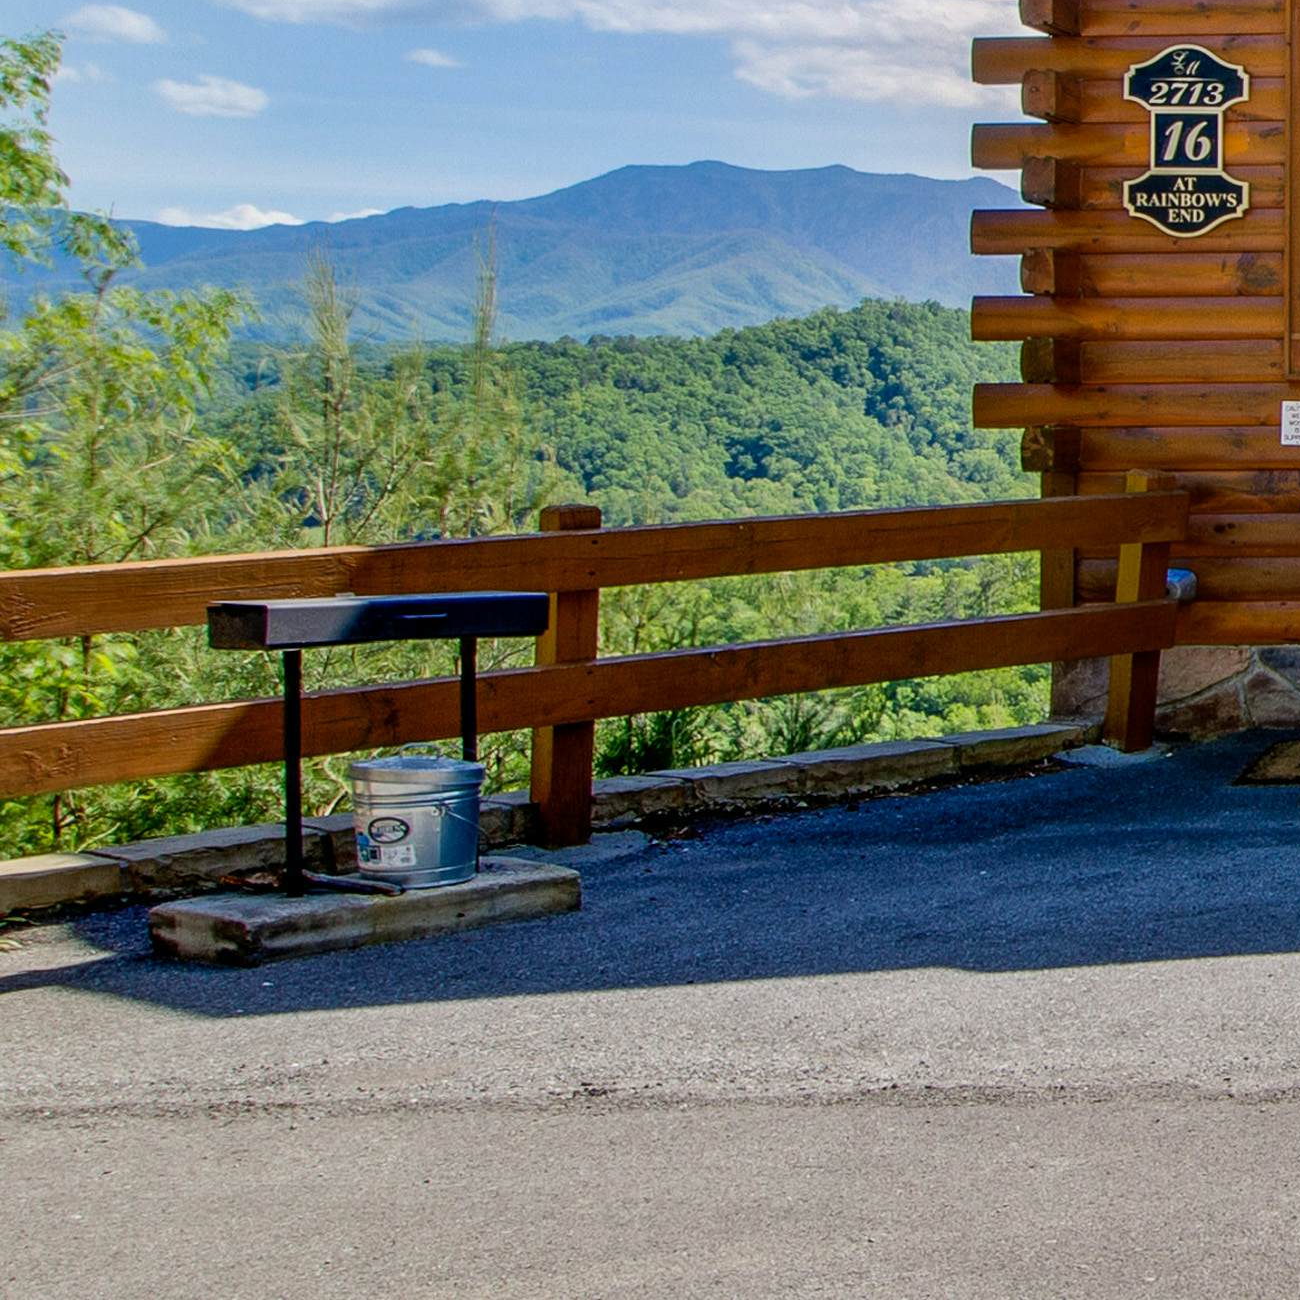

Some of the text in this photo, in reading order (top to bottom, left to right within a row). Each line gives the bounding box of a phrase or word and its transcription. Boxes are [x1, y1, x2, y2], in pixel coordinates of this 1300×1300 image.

[1149, 82, 1225, 105] 2713
[1162, 120, 1212, 161] 16
[1173, 176, 1198, 191] AT
[1135, 192, 1238, 208] RAINBOW'S
[1167, 208, 1206, 223] END
